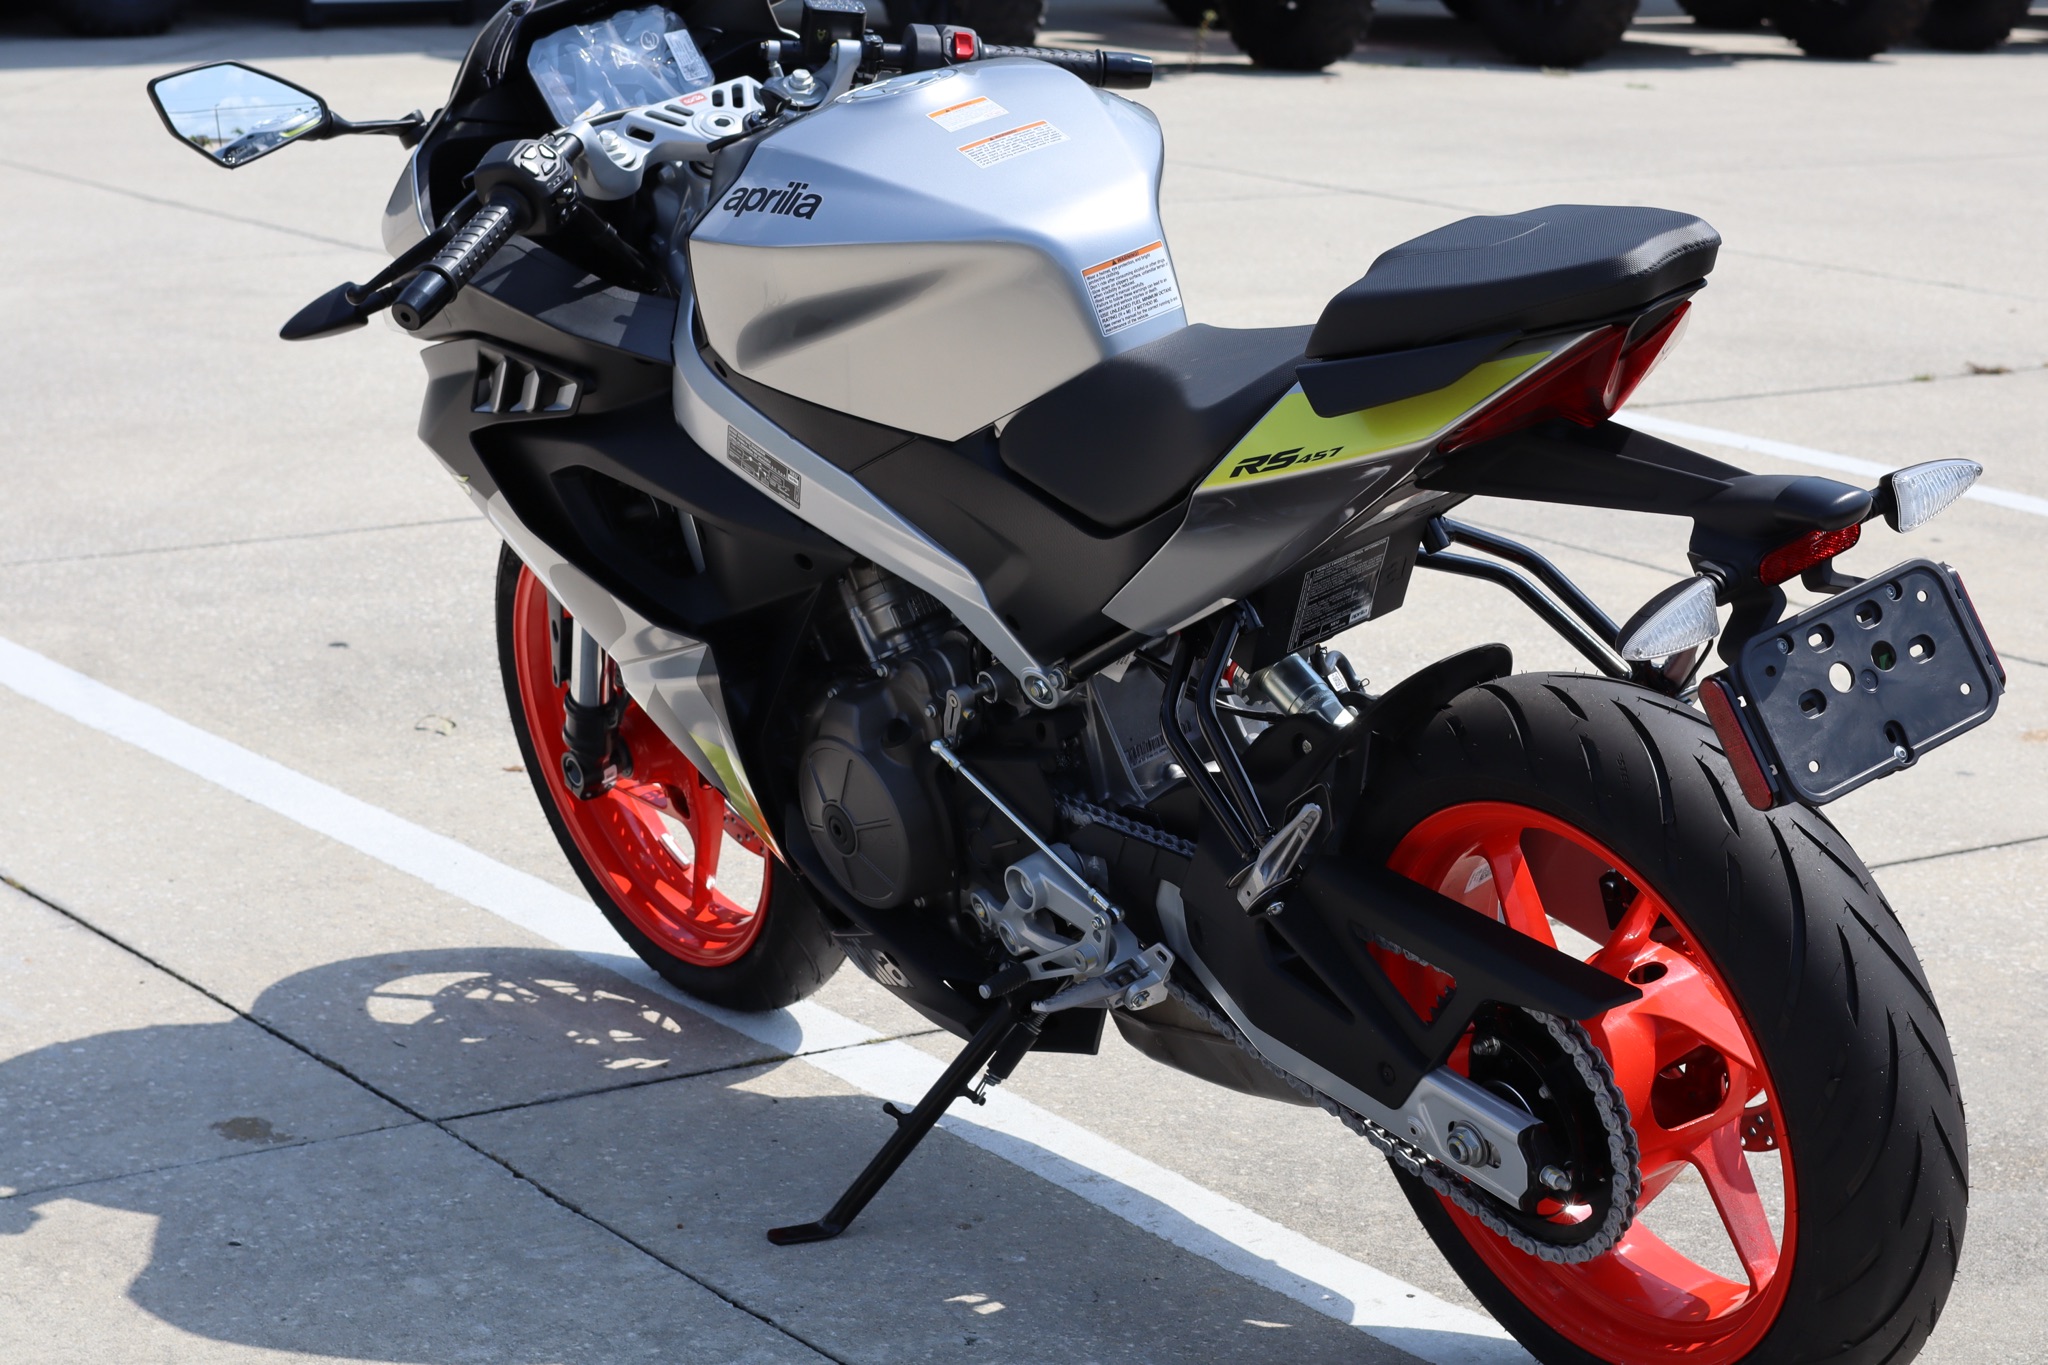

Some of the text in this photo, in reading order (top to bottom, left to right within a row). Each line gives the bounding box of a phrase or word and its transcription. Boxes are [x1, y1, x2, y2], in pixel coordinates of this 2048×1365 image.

[723, 181, 823, 220] aprilia
[1229, 446, 1345, 478] RS 457
